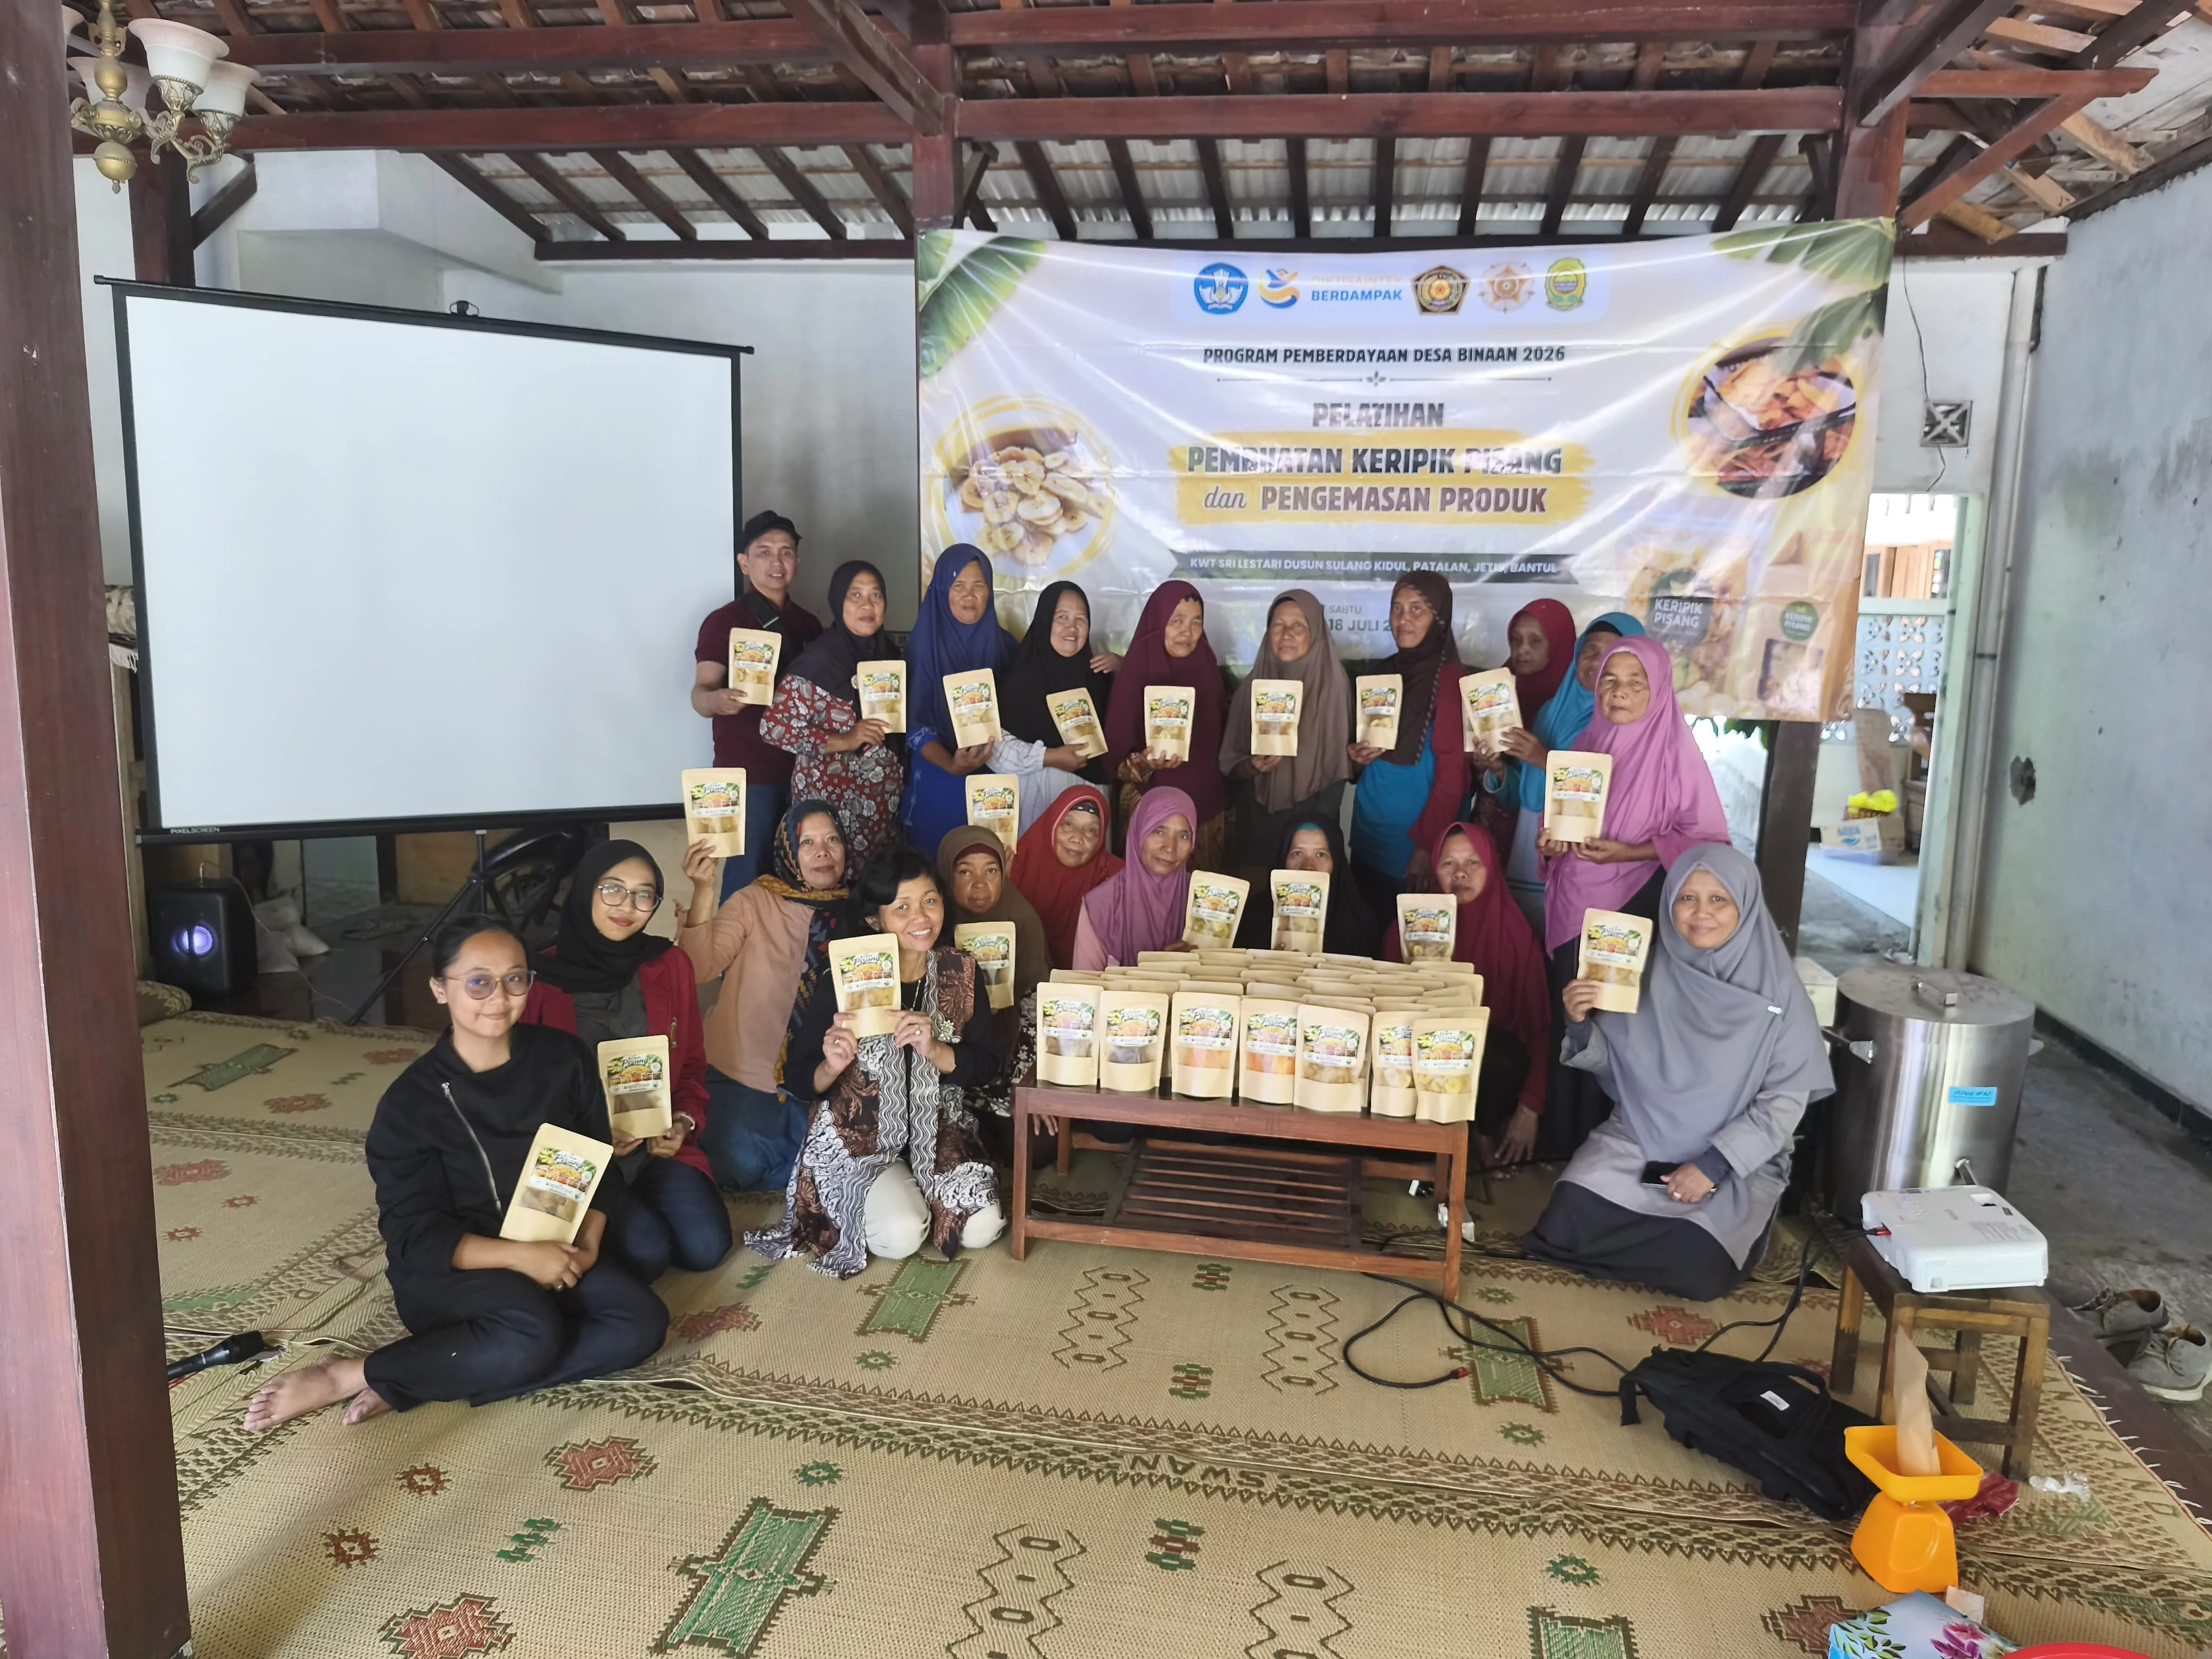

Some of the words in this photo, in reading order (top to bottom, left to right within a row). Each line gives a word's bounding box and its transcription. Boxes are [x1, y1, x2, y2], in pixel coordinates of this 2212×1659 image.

[1311, 290, 1403, 301] BERDAMPAK
[1204, 348, 1277, 363] PROGRAM
[1283, 348, 1408, 363] PEMBERDAYAAN
[1413, 348, 1452, 362] DESA
[1457, 347, 1517, 362] BINAAN
[1522, 346, 1565, 362] 2026
[1312, 403, 1444, 427] PELATIHAN
[1352, 448, 1456, 473] KERIPIK
[1204, 486, 1246, 509] dan
[1261, 486, 1430, 511] PENGEMASAN
[1439, 487, 1547, 512] PRODUK
[1190, 558, 1216, 568] KWT
[1218, 559, 1236, 568] SRI
[1238, 559, 1282, 569] LESTARI
[1284, 560, 1323, 570] DUSUN
[1325, 560, 1371, 570] SULANG
[1374, 561, 1410, 572] KIDUL,
[1413, 561, 1471, 573] PATALAN,
[1510, 562, 1557, 573] BANTUL
[1329, 605, 1362, 614] SABTU
[1655, 599, 1702, 614] KERIPIK
[1329, 619, 1343, 631] 18
[1347, 620, 1379, 632] JULI
[1654, 612, 1699, 628] PISANG
[622, 1058, 649, 1067] Pisang
[554, 1153, 584, 1168] Pisang
